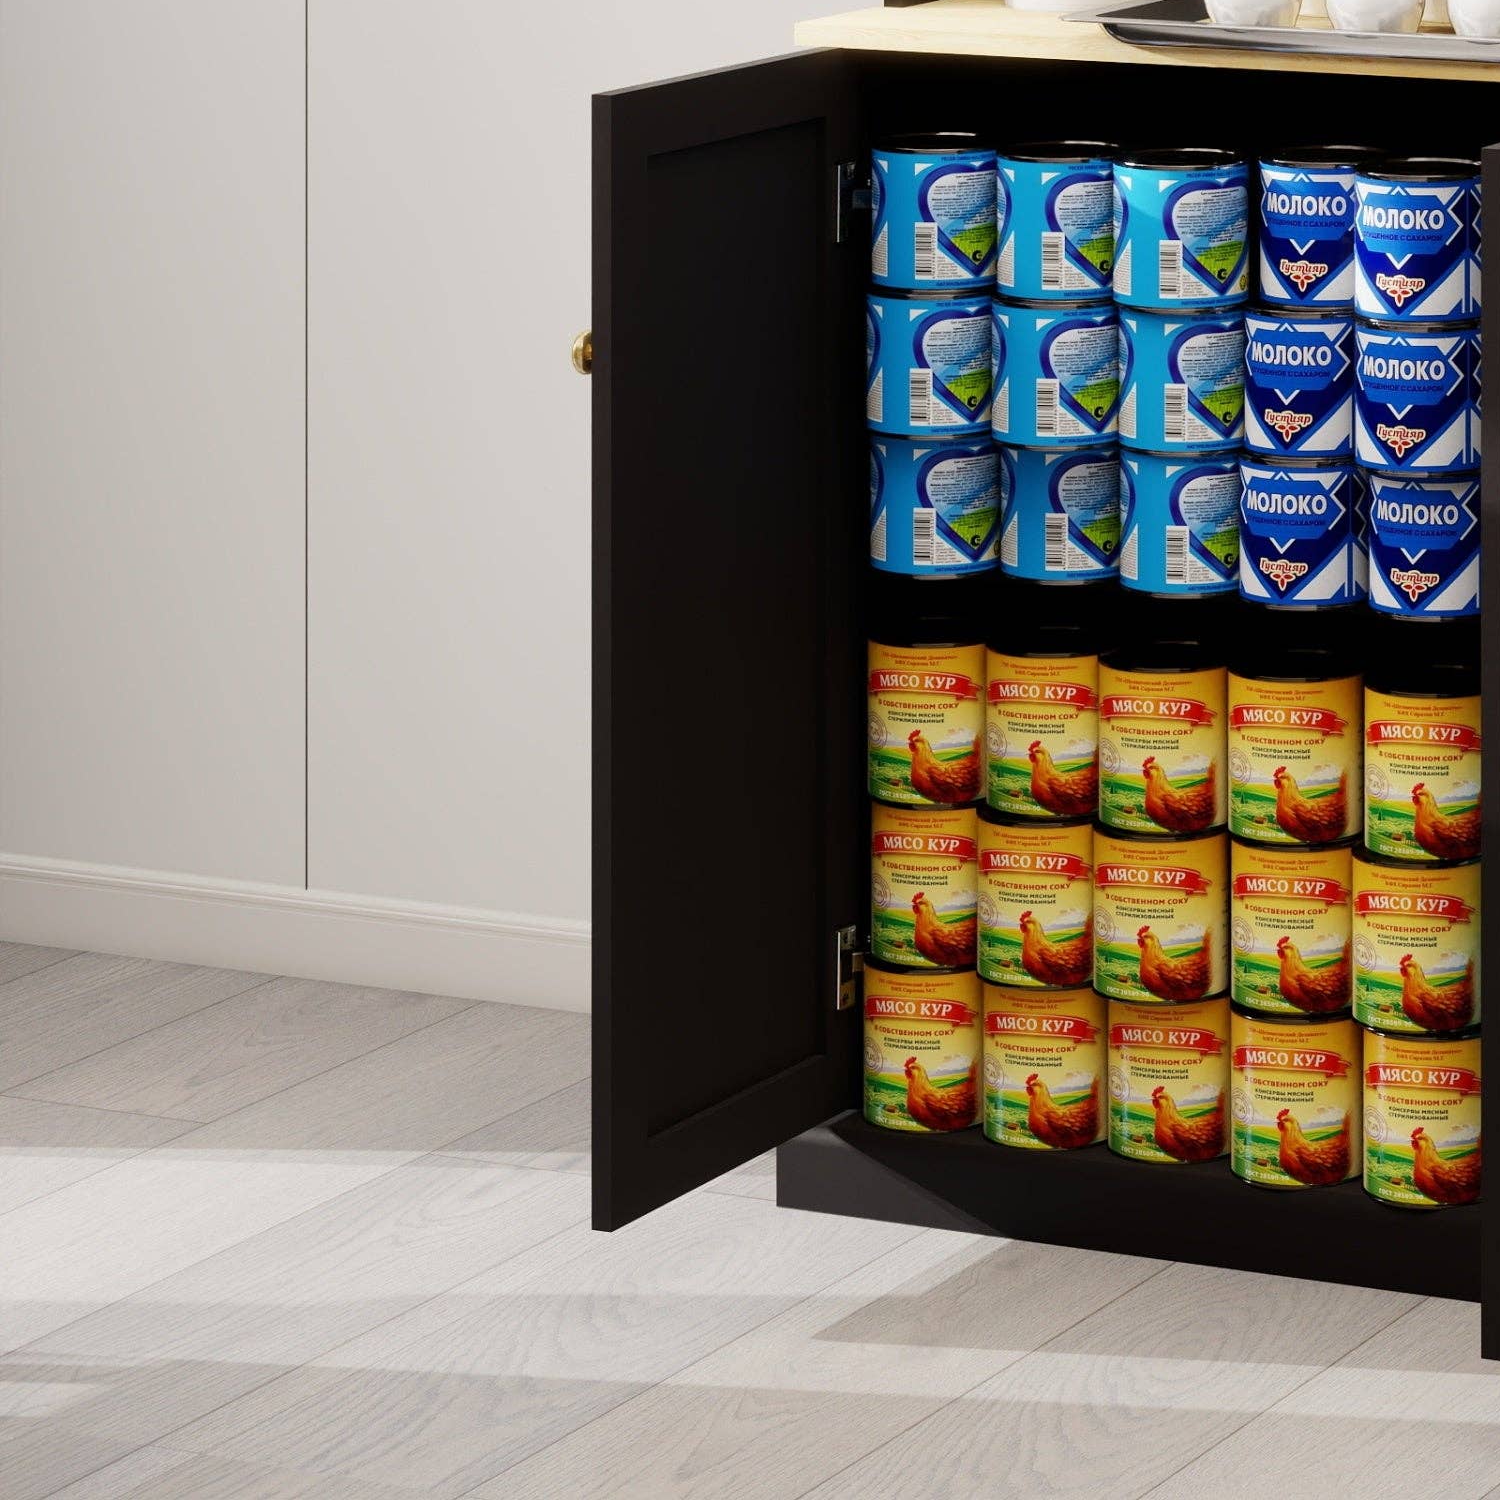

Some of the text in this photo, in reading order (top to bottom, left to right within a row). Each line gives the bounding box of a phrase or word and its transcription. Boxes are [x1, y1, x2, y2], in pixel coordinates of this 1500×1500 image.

[1266, 192, 1347, 216] МОЛОКО
[1362, 205, 1445, 230] МОЛОКО
[1251, 341, 1332, 366] МОЛОКО
[1363, 355, 1446, 381] МОЛОКО
[1246, 490, 1327, 515] МОЛОКО
[1376, 500, 1459, 525] МОЛОКО
[879, 673, 957, 690] МЯСО КУР
[999, 684, 1078, 700] МЯСО КУР
[1112, 699, 1192, 716] МЯСО КУР
[1243, 708, 1324, 725] МЯСО КУР
[1115, 726, 1171, 736] СОБСТВЕННОМ
[1380, 724, 1462, 742] МЯСО КУР
[1246, 736, 1302, 746] СОБСТВЕННОМ
[1383, 752, 1441, 762] СОБСТВЕННОМ
[883, 835, 960, 852] МЯСО КУР
[990, 853, 1069, 871] МЯСО КУР
[1107, 868, 1187, 885] МЯСО КУР
[1246, 878, 1327, 895] МЯСО КУР
[1249, 905, 1306, 915] СОБСТВЕННОМ
[1307, 908, 1329, 916] СОКУ
[1368, 895, 1450, 913] МЯСО КУР
[875, 1000, 953, 1017] МЯСО КУР
[996, 1016, 1075, 1033] МЯСО КУР
[1121, 1028, 1201, 1046] МЯСО КУР
[1245, 1050, 1327, 1068] МЯСО КУР
[1379, 1068, 1462, 1086] МЯСО КУР
